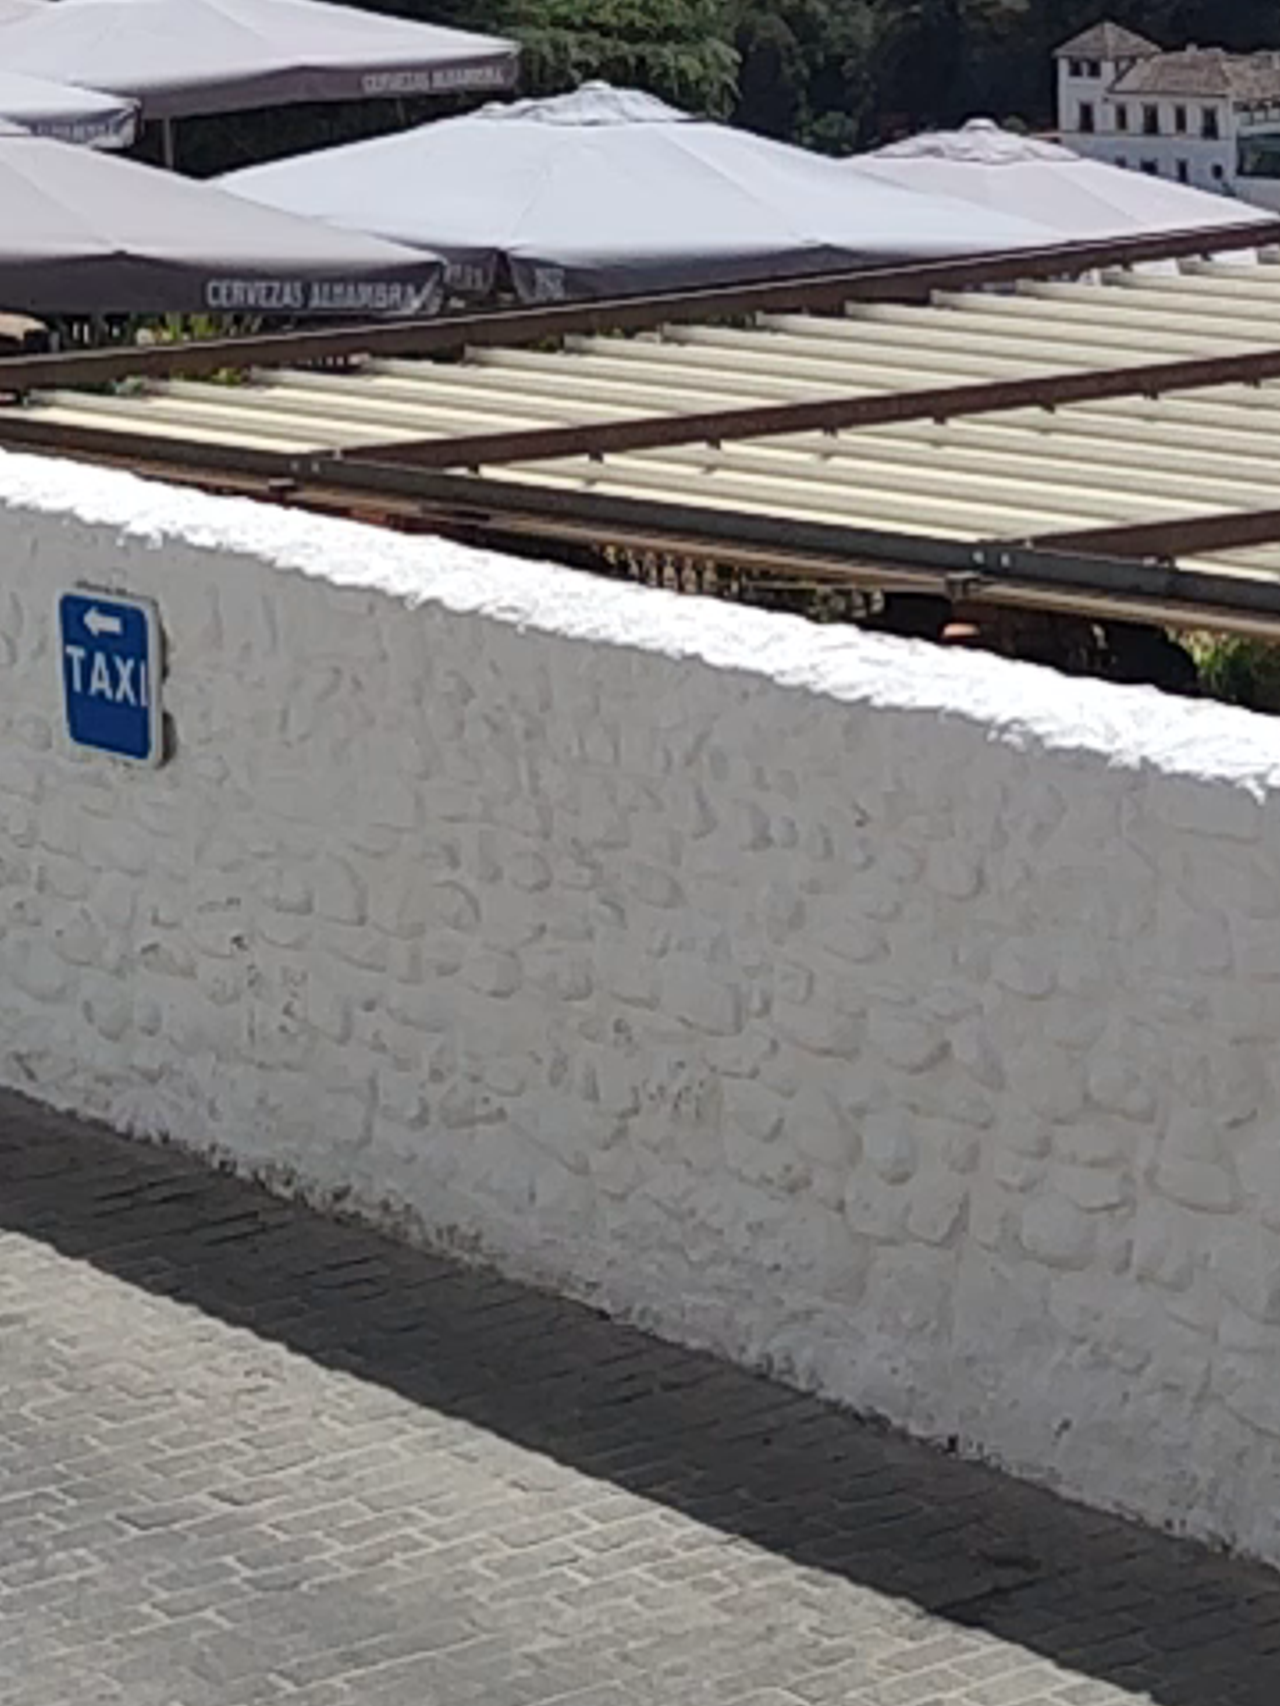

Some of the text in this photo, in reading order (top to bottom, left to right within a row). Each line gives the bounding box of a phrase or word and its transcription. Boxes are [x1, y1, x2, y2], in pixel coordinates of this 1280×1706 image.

[206, 278, 418, 310] CERVEZAS ALHAMBRA
[65, 645, 148, 708] TAXI
